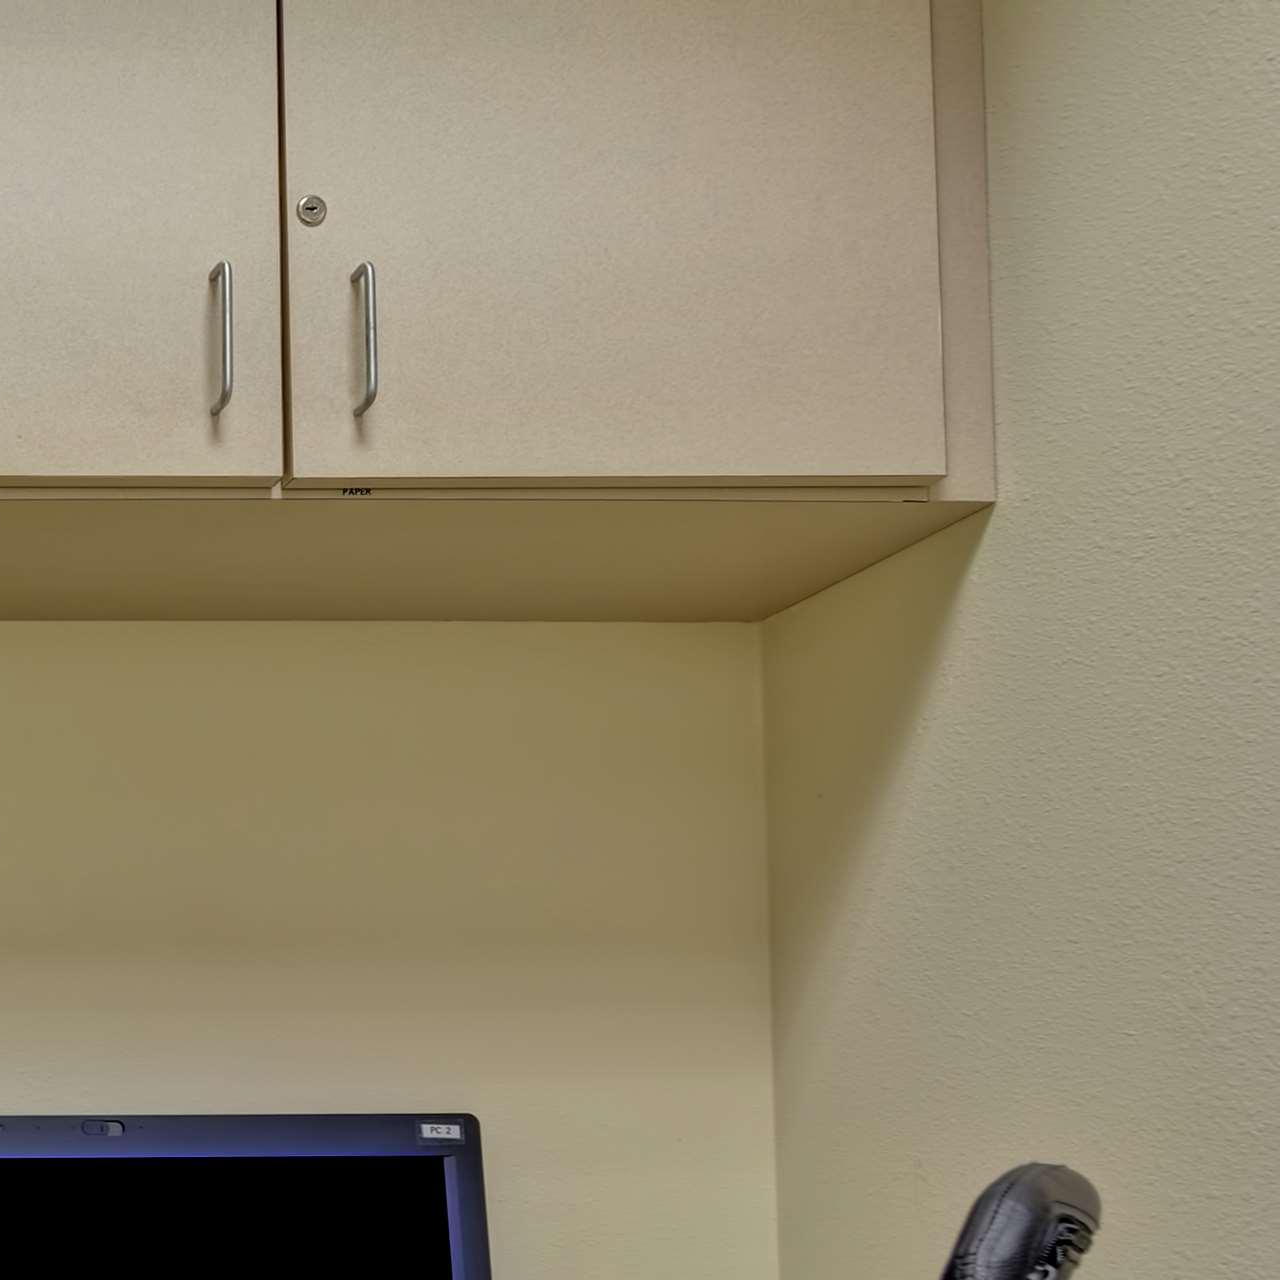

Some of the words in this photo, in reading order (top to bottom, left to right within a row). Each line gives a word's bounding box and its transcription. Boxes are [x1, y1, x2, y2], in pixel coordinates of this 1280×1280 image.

[342, 487, 372, 496] PAPER
[430, 1126, 442, 1135] PC
[445, 1126, 452, 1135] 2
